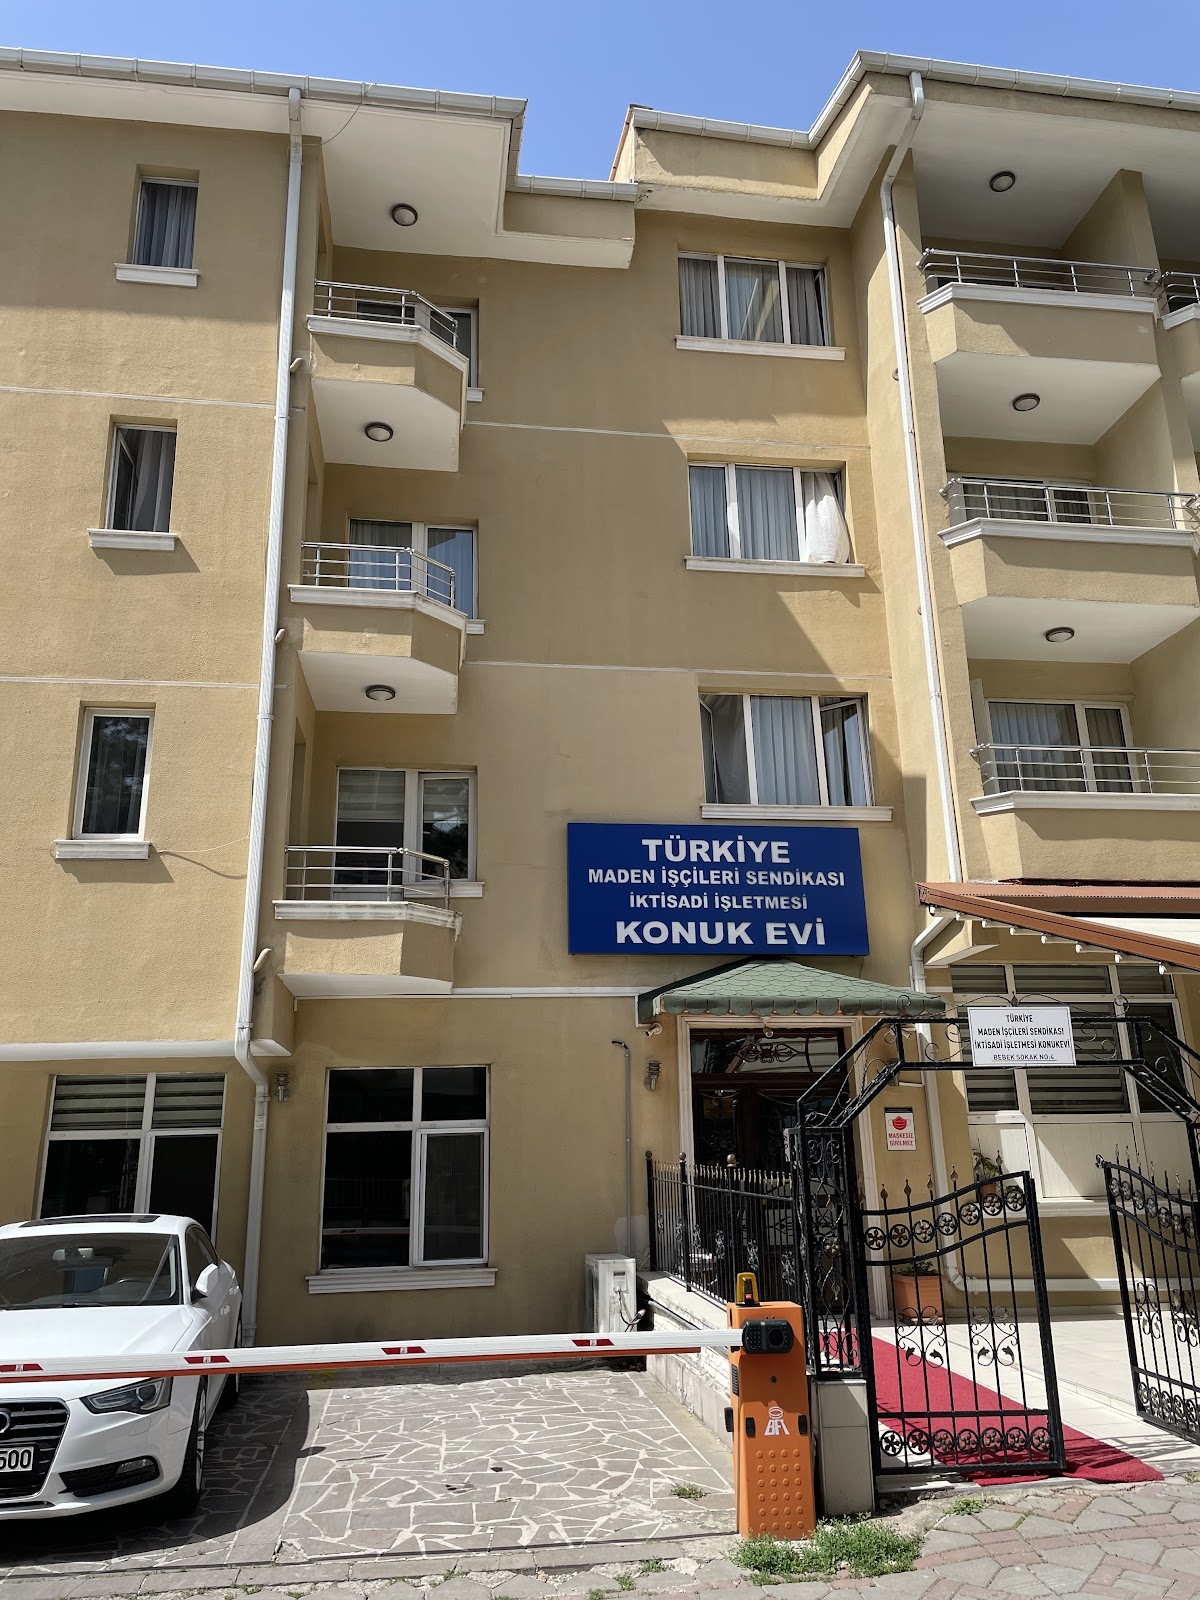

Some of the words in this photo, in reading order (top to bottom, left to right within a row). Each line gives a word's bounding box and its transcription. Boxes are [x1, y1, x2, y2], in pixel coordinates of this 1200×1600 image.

[642, 835, 790, 864] TÜRKİYE
[588, 868, 655, 884] MADEN
[661, 866, 740, 887] İŞÇİLERİ
[746, 868, 845, 886] SENDİKASI
[629, 891, 709, 909] İKTİSADİ
[715, 892, 808, 912] İŞLETMESİ
[616, 921, 754, 945] KONUK
[765, 917, 825, 945] EVİ
[1005, 1013, 1033, 1023] TÜRKİYE
[977, 1028, 1000, 1036] MADEN
[1002, 1026, 1029, 1037] İŞÇİLERİ
[1030, 1026, 1064, 1036] SENDİKASI
[974, 1039, 1003, 1049] İKTİSADİ
[1004, 1039, 1037, 1050] İŞLETMESİ
